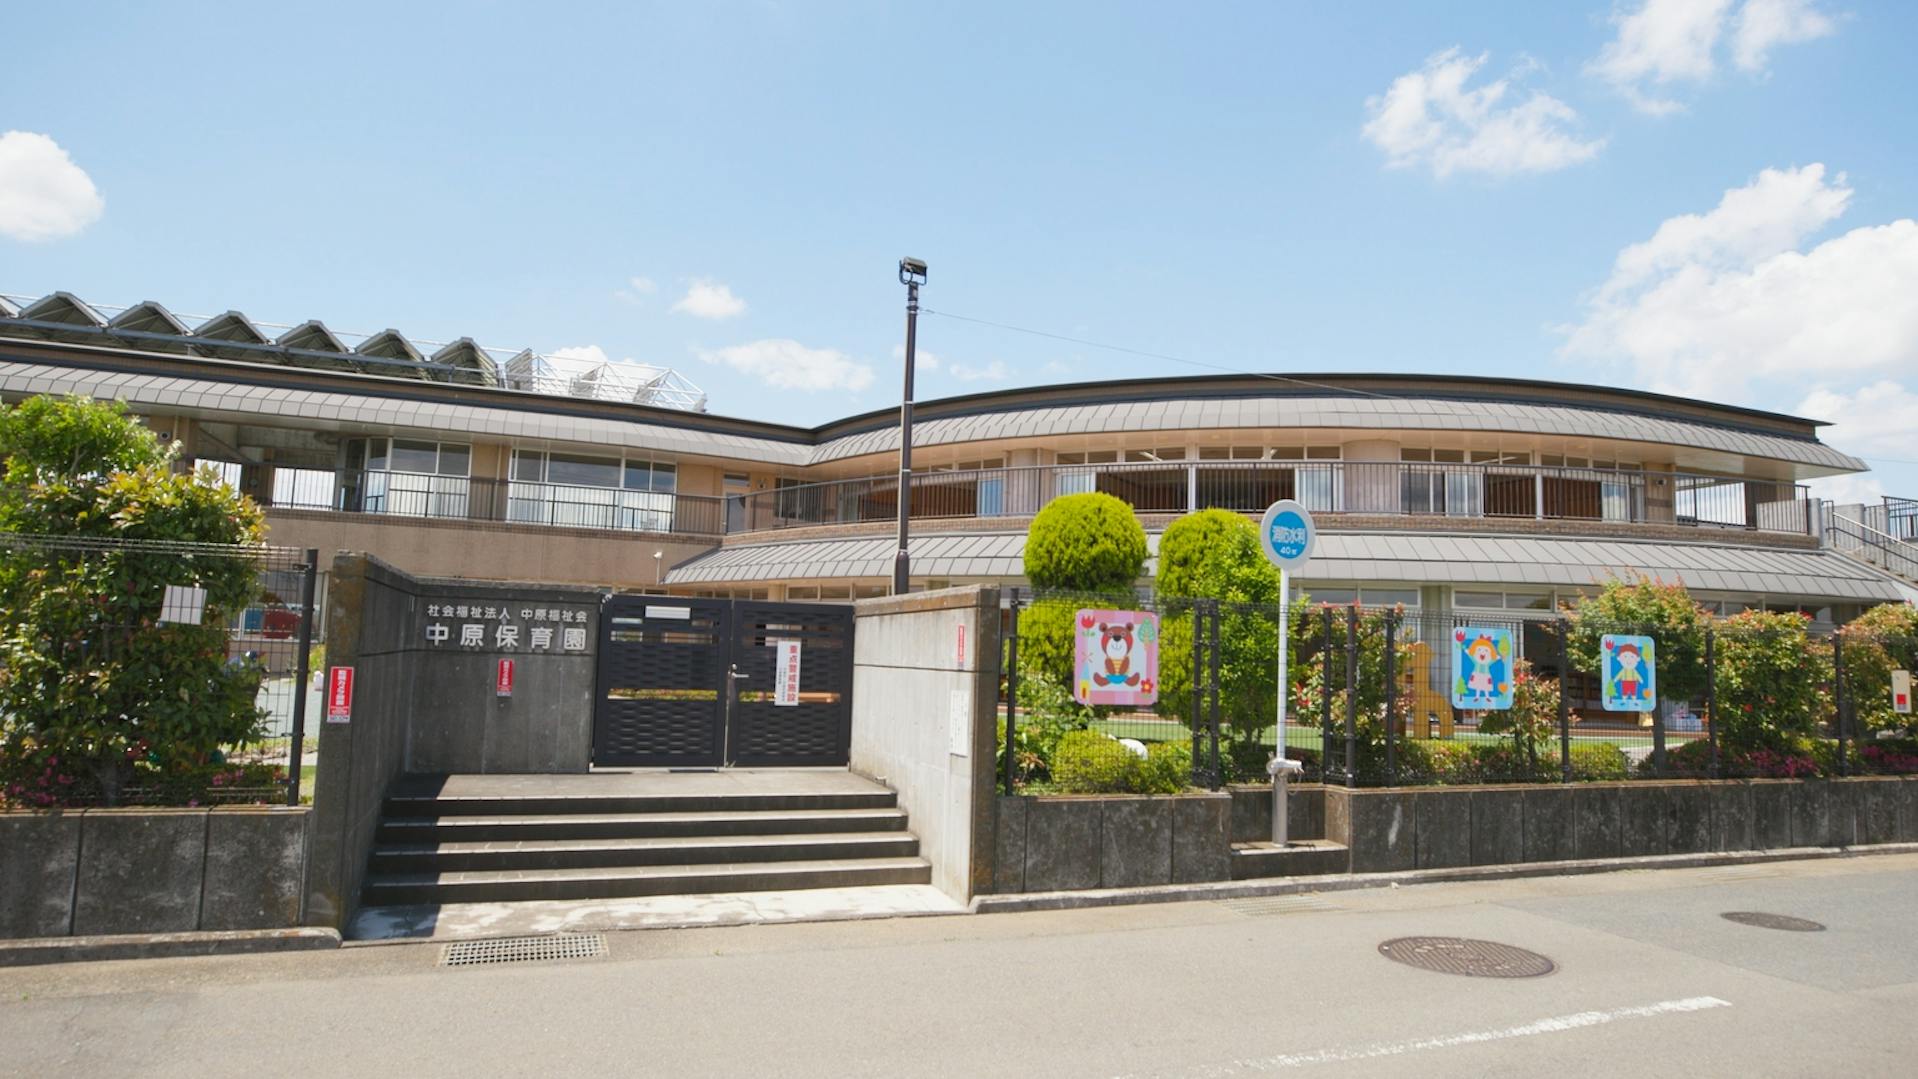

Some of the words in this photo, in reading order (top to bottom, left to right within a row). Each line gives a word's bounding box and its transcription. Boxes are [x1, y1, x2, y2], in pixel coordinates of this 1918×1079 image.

[427, 604, 511, 620] 社会福祉法人
[521, 608, 588, 623] 中原福祉会
[426, 623, 586, 650] 中原保育園
